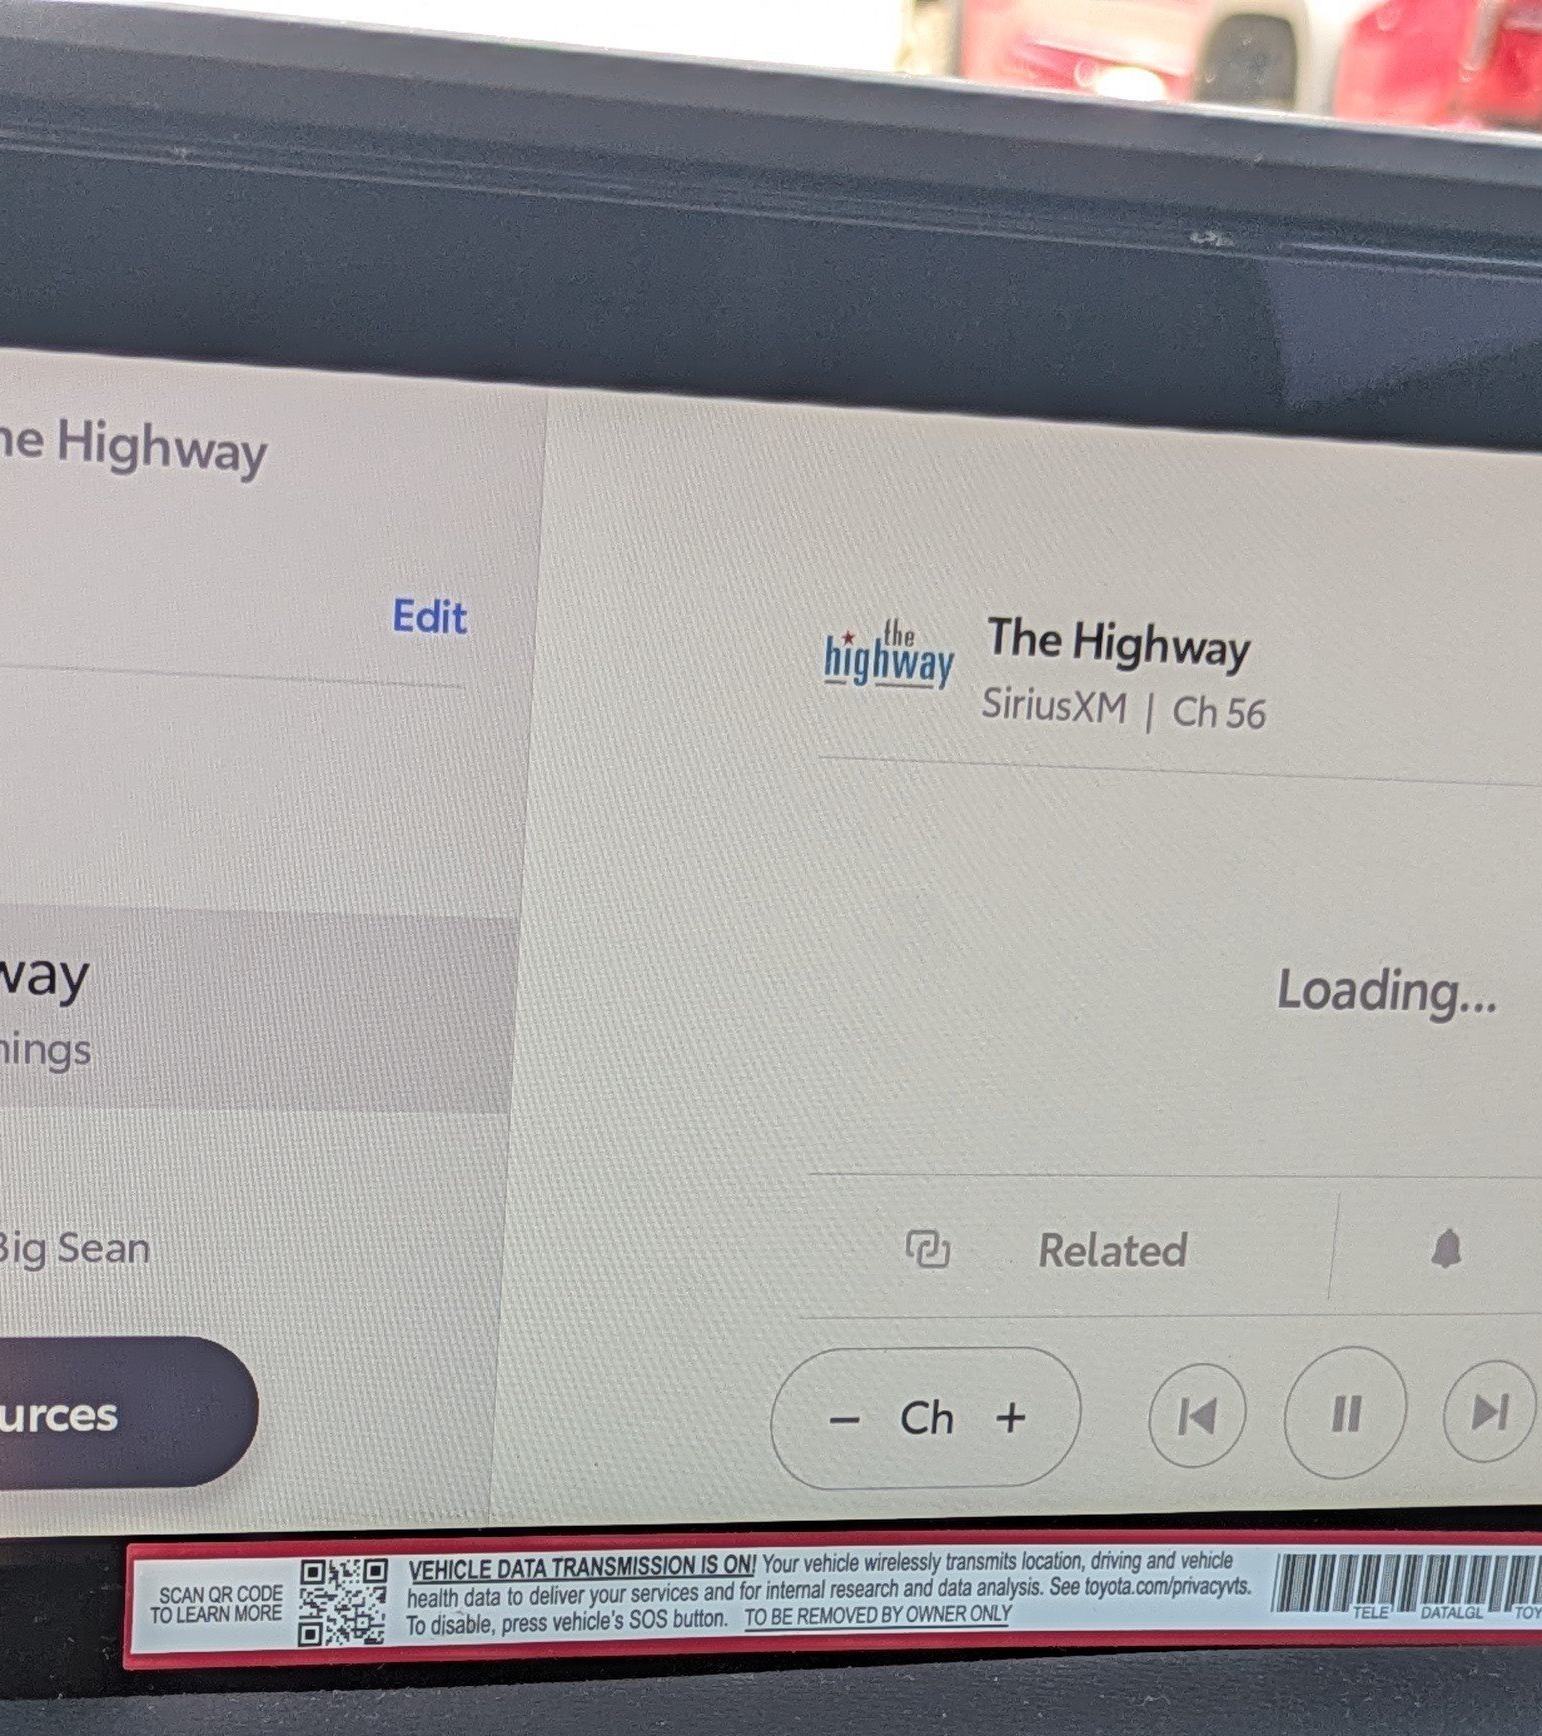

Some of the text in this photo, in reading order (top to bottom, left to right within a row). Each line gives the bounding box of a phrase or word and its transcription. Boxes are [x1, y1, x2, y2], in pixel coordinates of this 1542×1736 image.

[57, 417, 268, 484] Highway
[393, 597, 467, 636] Edit
[884, 618, 915, 648] the
[825, 635, 955, 689] highway
[988, 616, 1251, 677] The Highway
[982, 686, 1267, 730] SiriusXM Ch 56
[1278, 967, 1497, 1025] Loading...
[57, 1231, 151, 1267] Sean
[1039, 1232, 1188, 1270] Related
[900, 1400, 954, 1436] Ch
[409, 1550, 1233, 1580] VEHICLE DATA TRANSMISSION IS ON! Your vehicle wirelessly transmits location, driving and vehicle
[159, 1584, 283, 1604] SCAN QR CODE
[407, 1575, 1252, 1609] health data to deliver your services and for internal research and data analysis. See toyota.com/privacyvts.
[150, 1604, 282, 1624] TO LEARN MORE
[406, 1604, 1012, 1637] To disable, press vehicle's SOS button. TO BE REMOVED BY OWNER ONLY
[1353, 1606, 1389, 1619] TELE
[1421, 1606, 1483, 1619] DATALGL
